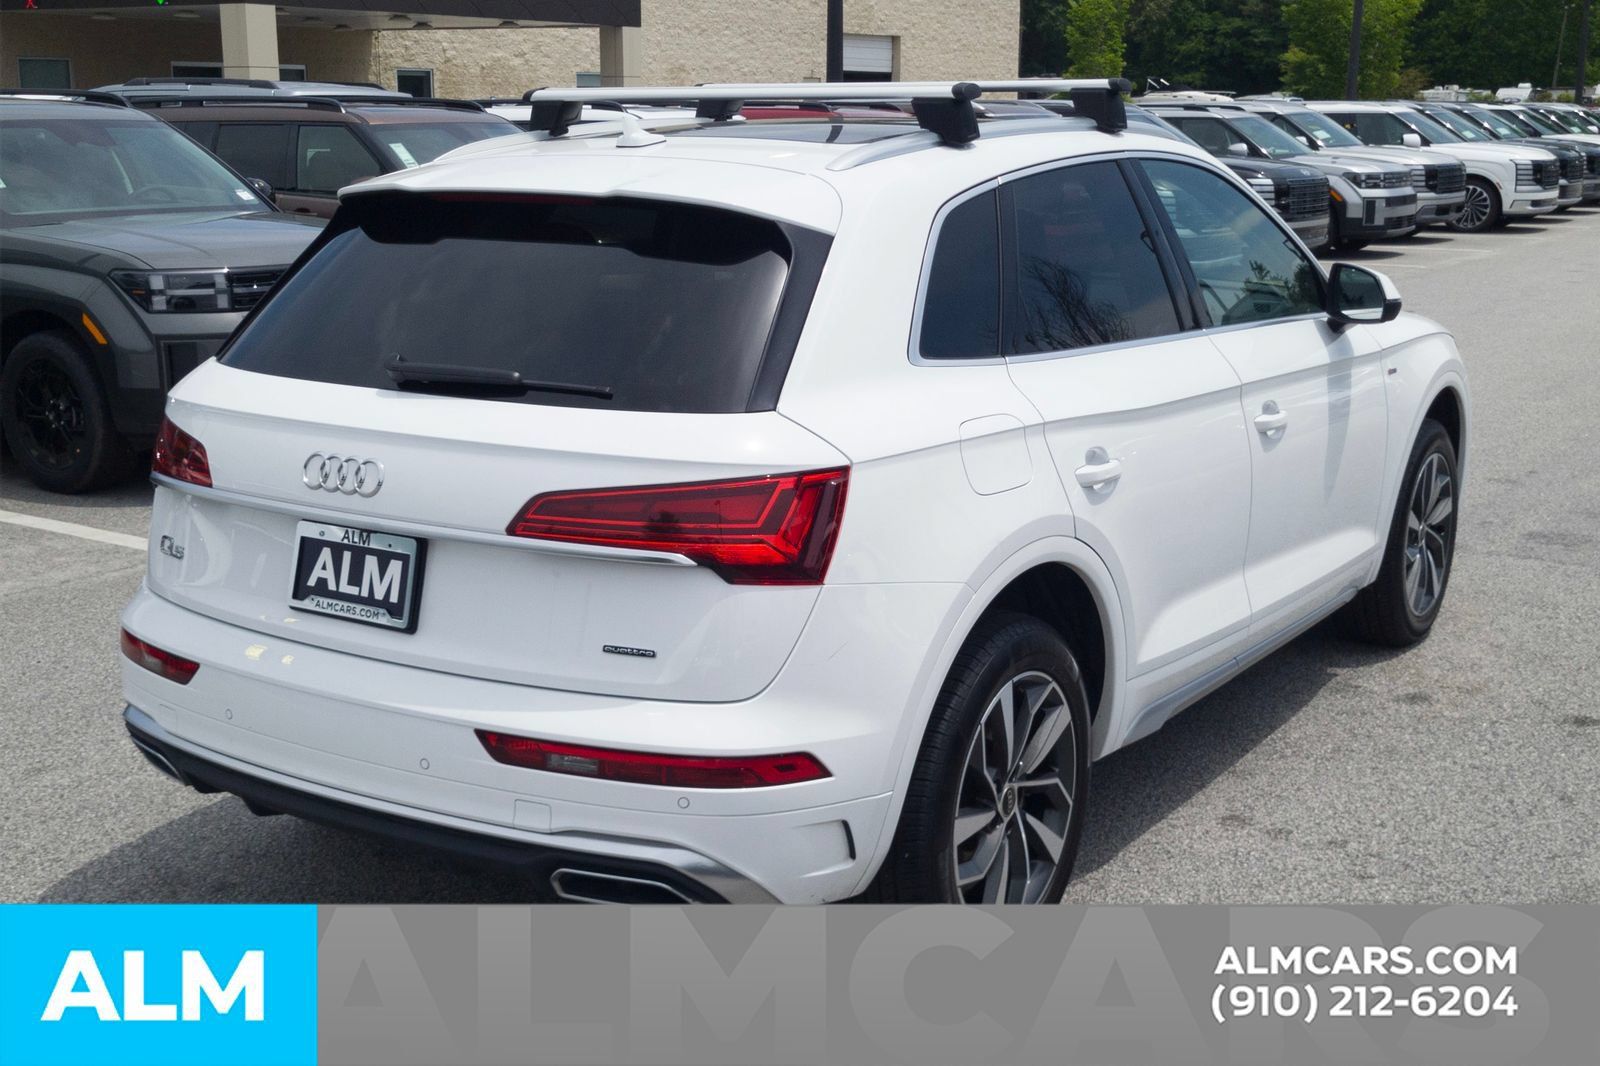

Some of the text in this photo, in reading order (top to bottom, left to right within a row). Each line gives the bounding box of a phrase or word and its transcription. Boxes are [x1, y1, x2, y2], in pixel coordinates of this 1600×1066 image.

[160, 535, 185, 560] Q5
[341, 529, 371, 547] ALM
[306, 547, 403, 604] ALM
[314, 599, 380, 620] ALMCARS.COM
[603, 645, 655, 657] quattro
